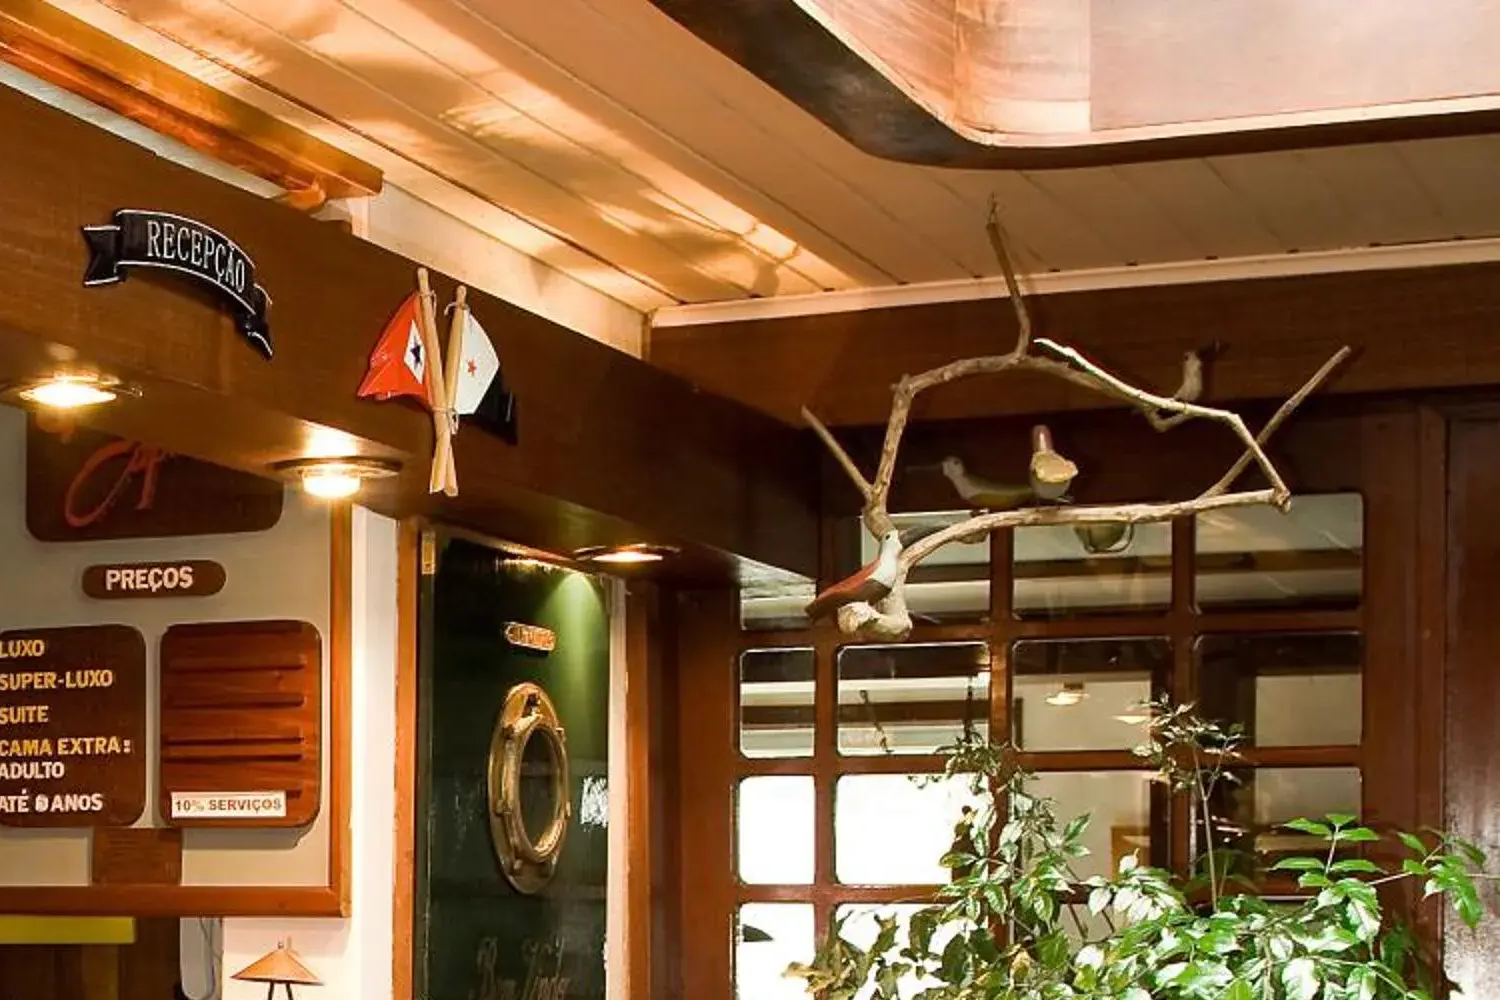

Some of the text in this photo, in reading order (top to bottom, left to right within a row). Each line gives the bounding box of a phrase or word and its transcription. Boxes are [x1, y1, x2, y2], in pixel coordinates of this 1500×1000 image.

[106, 565, 194, 593] PREÇOS
[57, 736, 132, 756] EXTRA:
[50, 793, 103, 813] ANOS
[209, 799, 283, 813] SERVIÇOS
